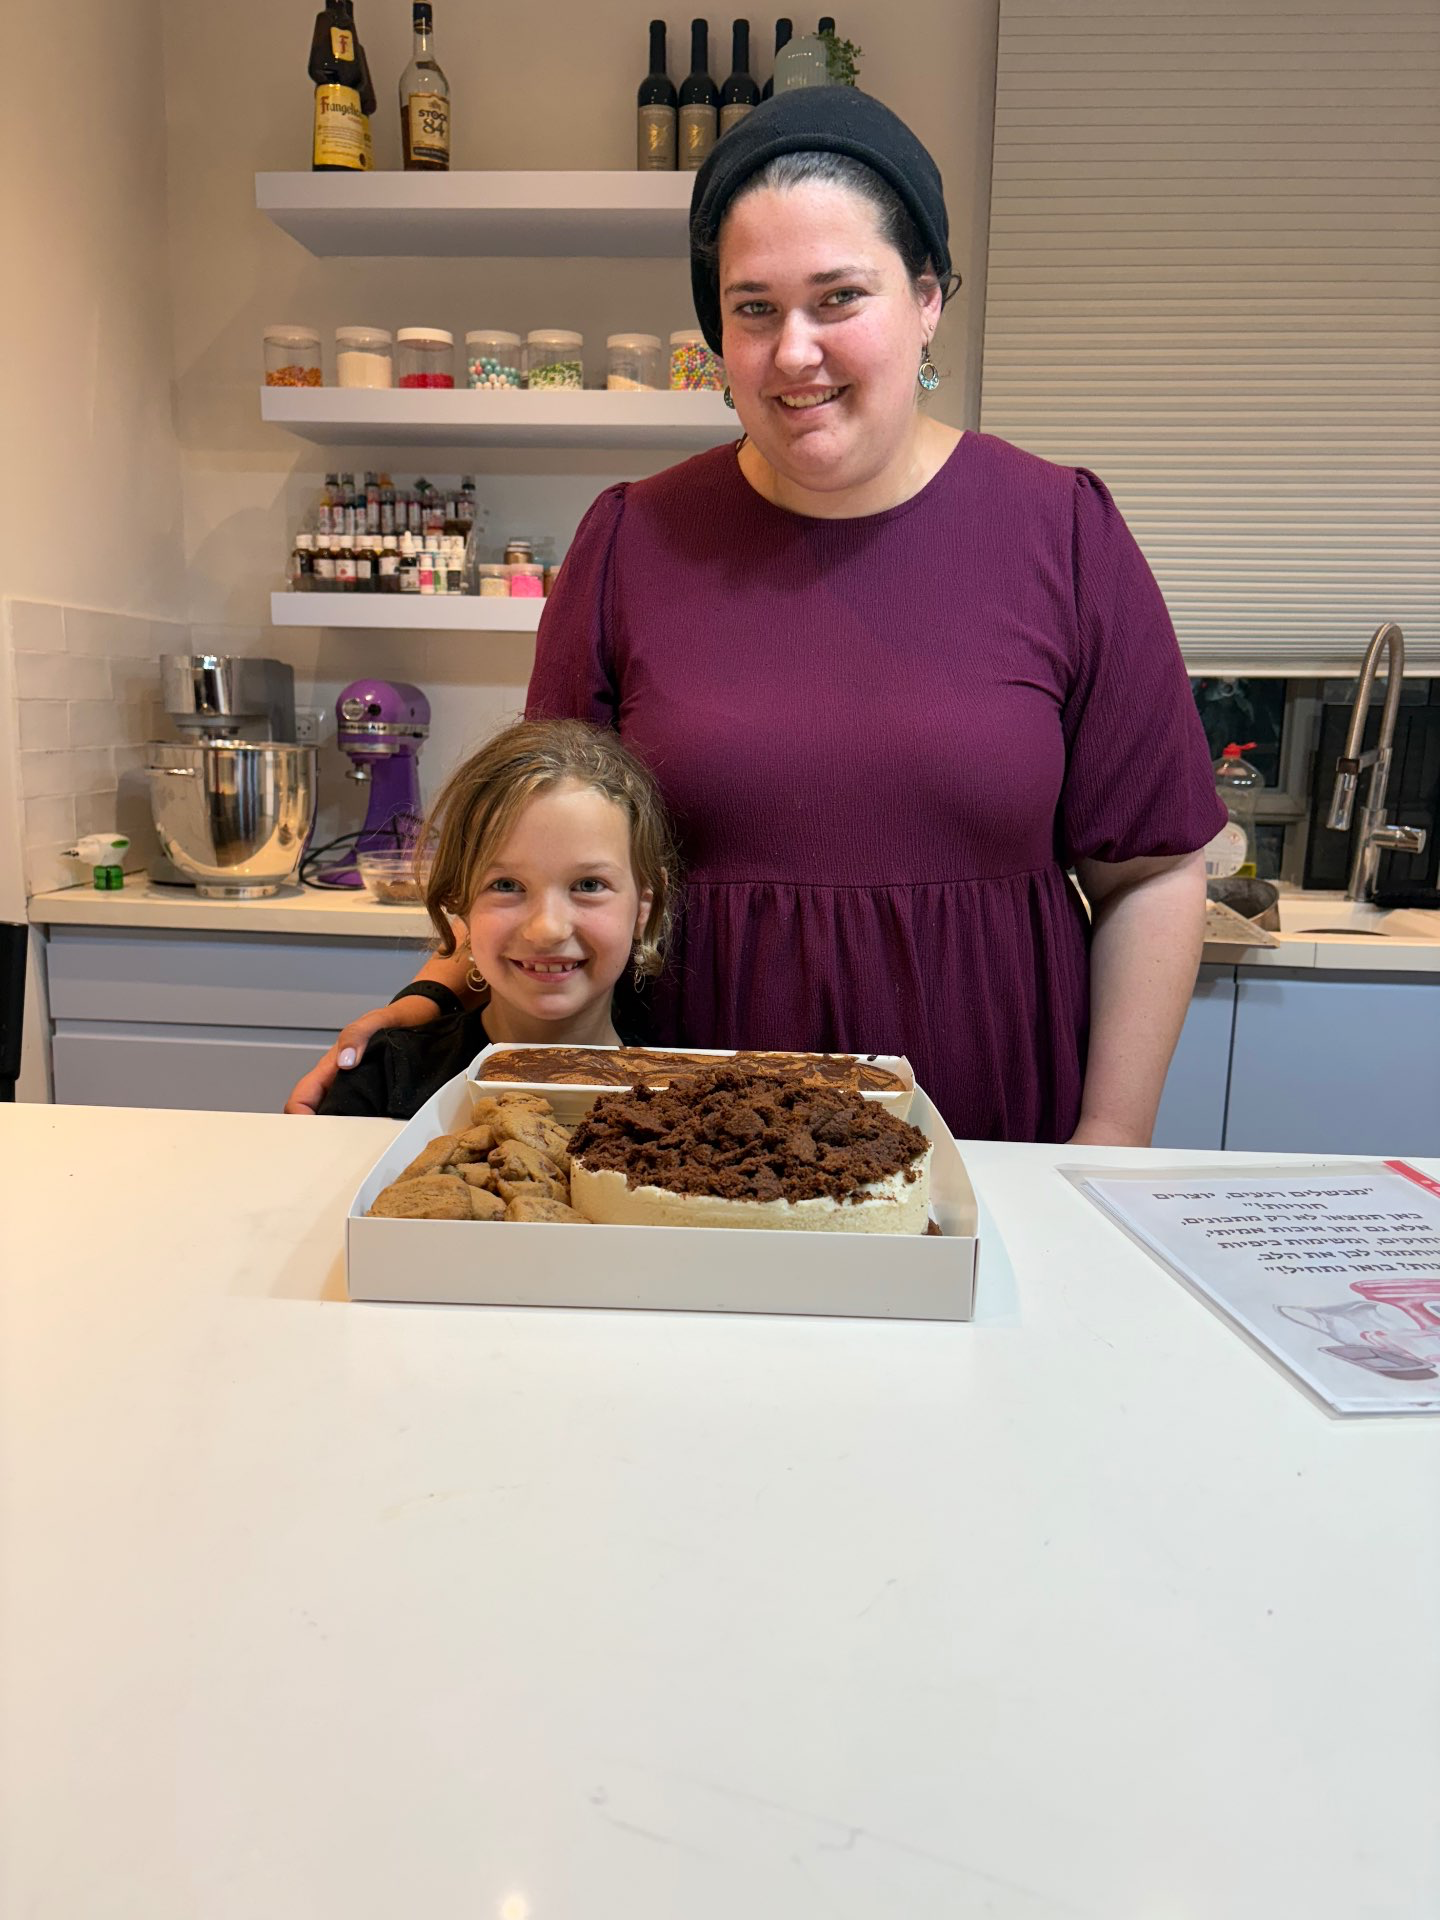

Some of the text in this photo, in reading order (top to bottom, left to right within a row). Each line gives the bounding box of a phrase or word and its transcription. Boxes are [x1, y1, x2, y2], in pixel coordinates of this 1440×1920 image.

[422, 117, 445, 136] 84
[1152, 1187, 1374, 1200] "מבשלים רגעים, יוצרים
[1242, 1202, 1329, 1210] חוויות!"
[1181, 1212, 1424, 1226] כאן תמצאו לא רק מתכונים,
[1205, 1226, 1266, 1238] אמיתי,
[1268, 1225, 1327, 1233] איכות
[1327, 1225, 1361, 1234] זמן
[1390, 1223, 1433, 1232] אלא
[1217, 1238, 1283, 1249] כיפיות
[1283, 1237, 1370, 1246] ומשימות
[1257, 1251, 1302, 1261] הלב.
[1303, 1251, 1337, 1259] את
[1337, 1248, 1371, 1259] לכן
[1263, 1261, 1440, 1275] נות? בואו נתחיל!"
